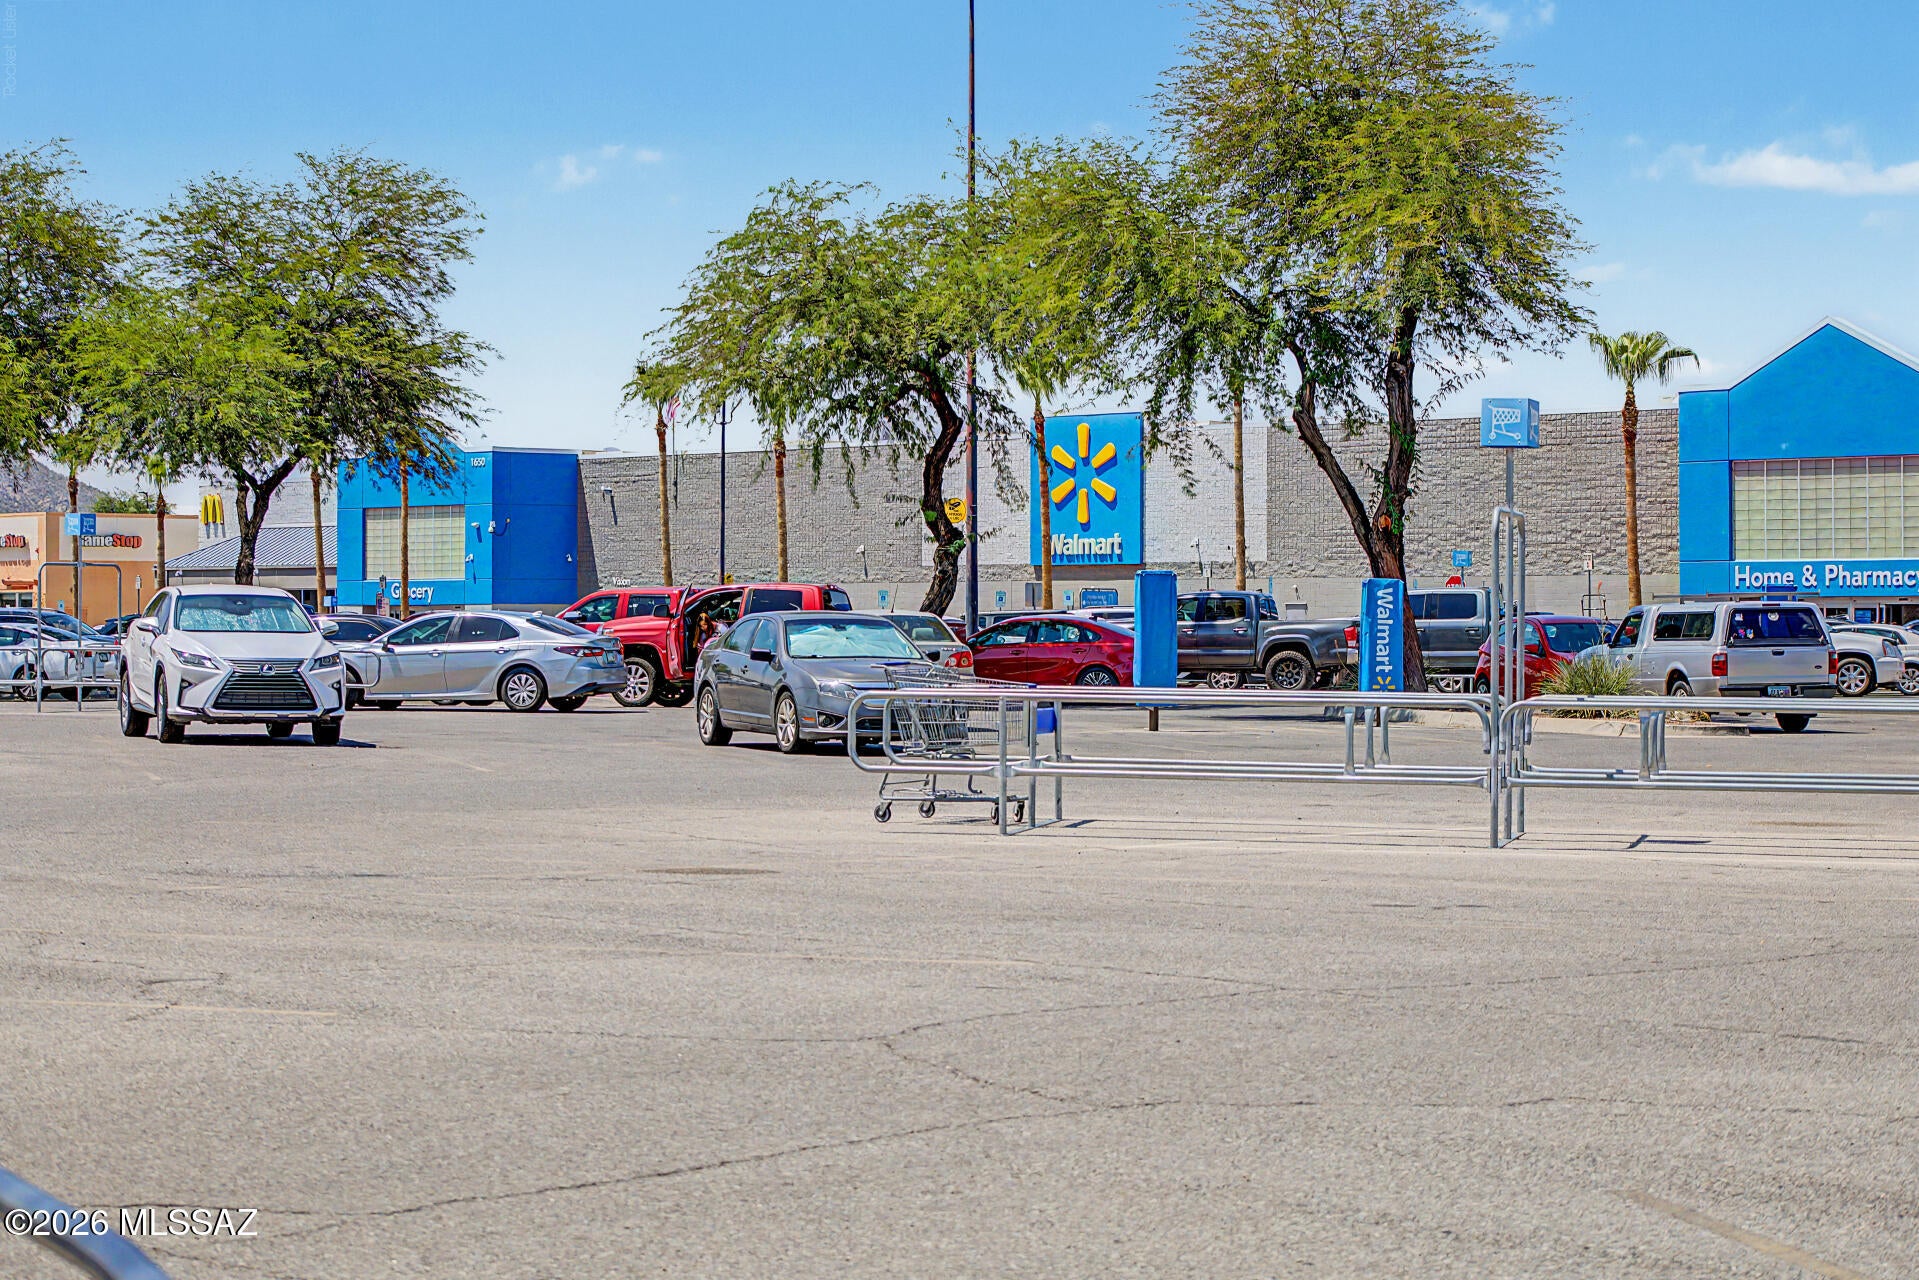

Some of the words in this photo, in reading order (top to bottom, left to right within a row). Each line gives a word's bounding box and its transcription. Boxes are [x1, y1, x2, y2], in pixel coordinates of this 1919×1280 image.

[470, 457, 486, 467] 1650
[1050, 532, 1122, 555] Walmart
[1734, 565, 1795, 587] Home
[1802, 564, 1818, 587] &
[1375, 587, 1394, 673] Walmart
